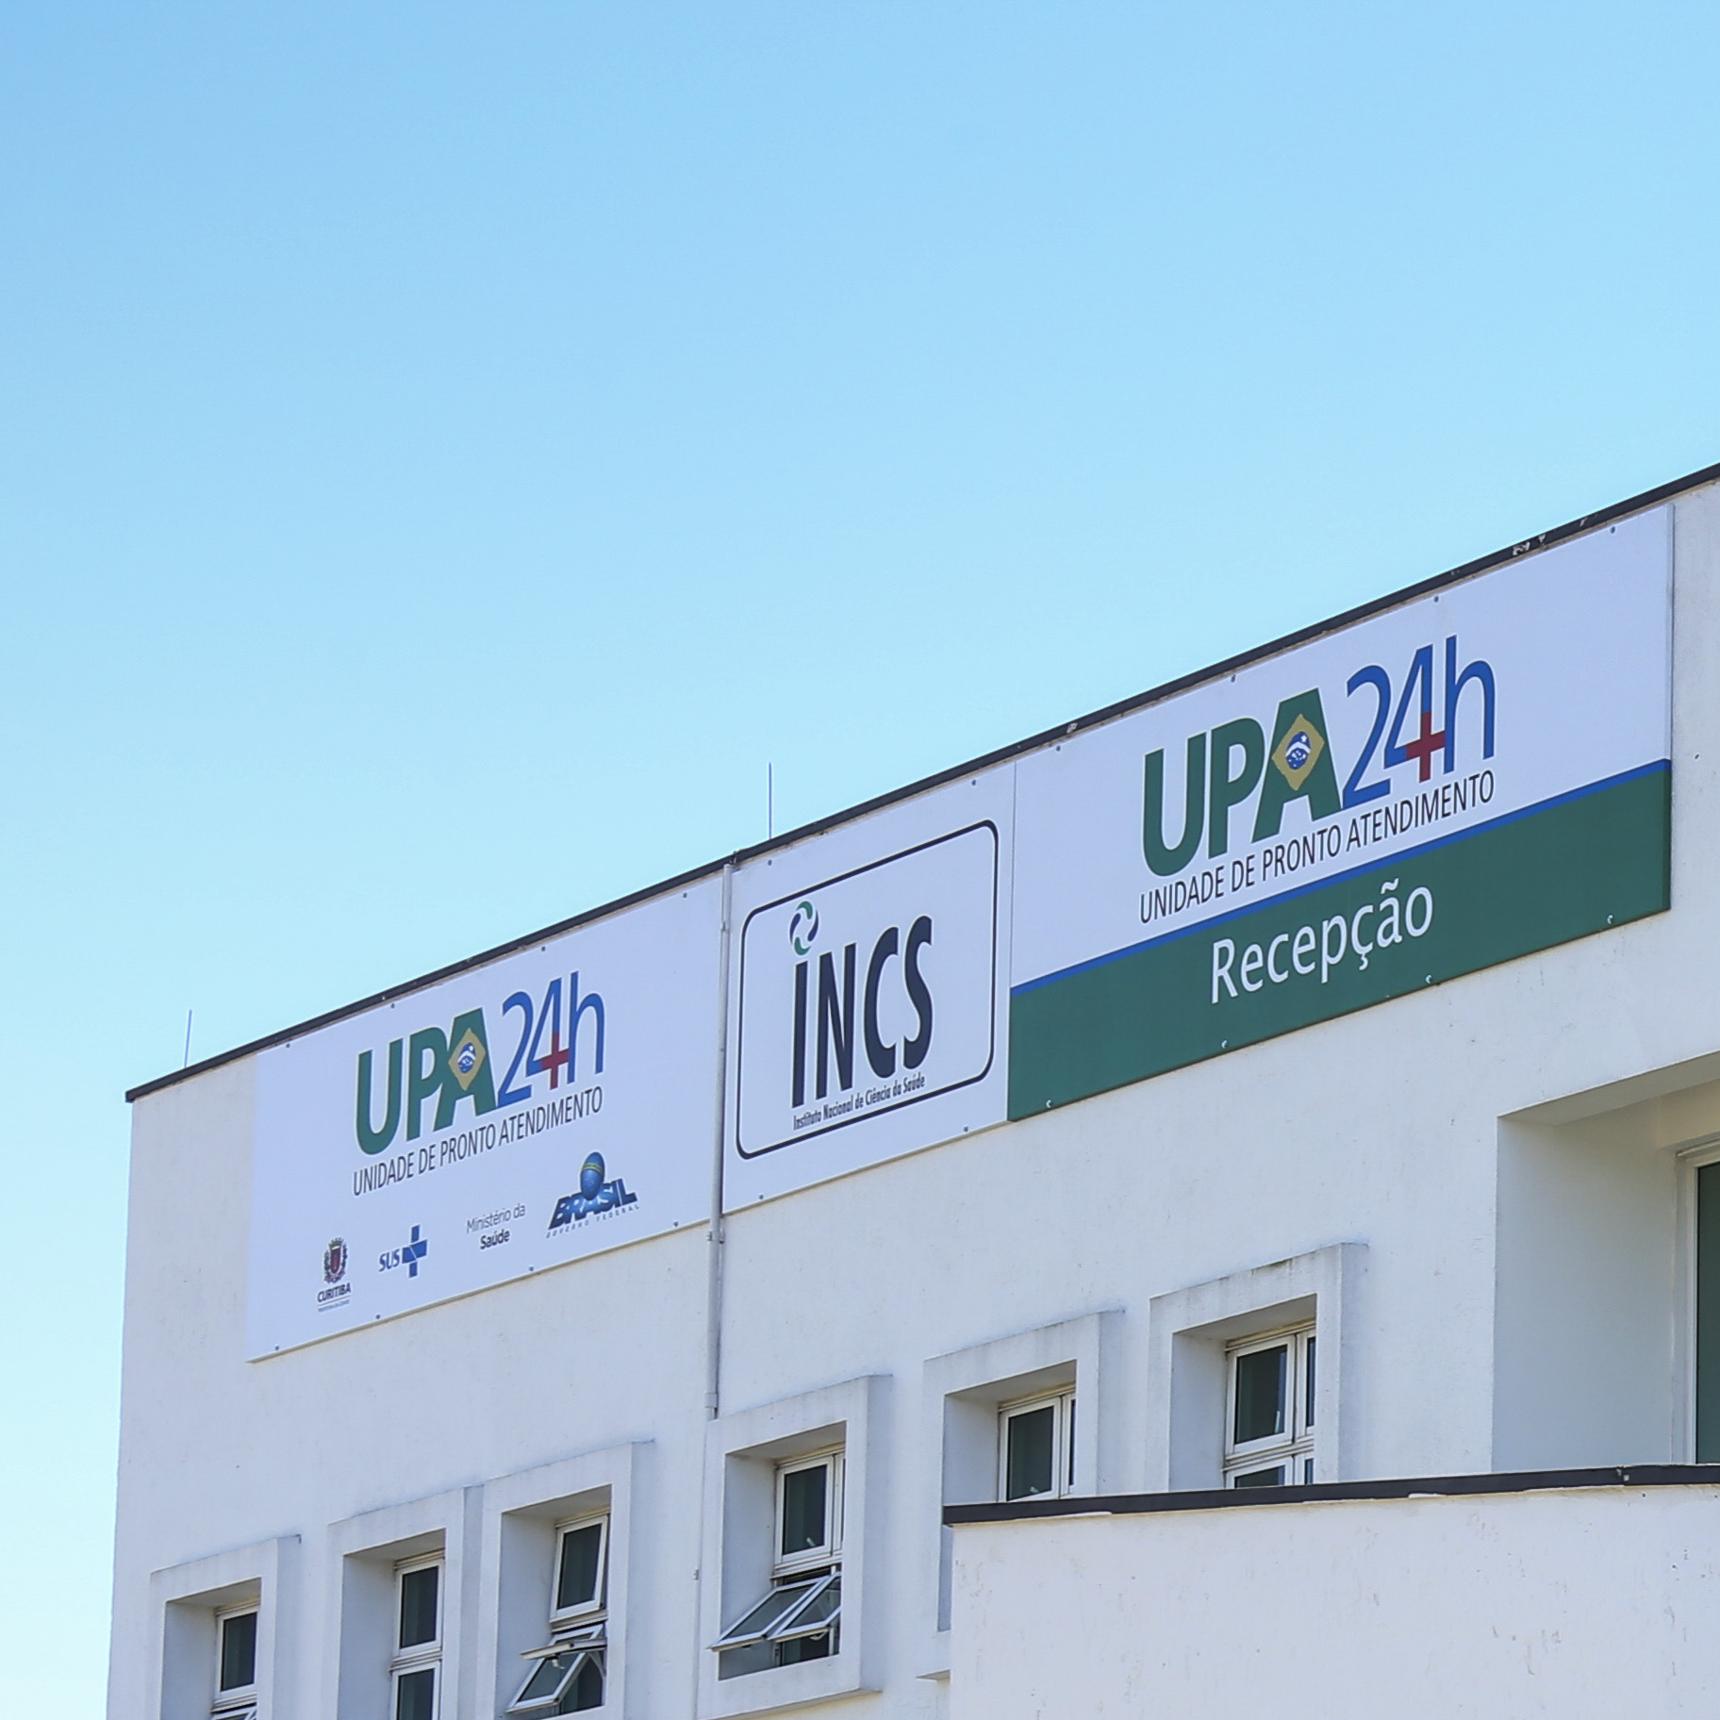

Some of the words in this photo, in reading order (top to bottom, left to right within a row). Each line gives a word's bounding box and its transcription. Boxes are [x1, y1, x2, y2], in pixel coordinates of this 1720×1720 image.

[1140, 865, 1225, 924] UNIDADE
[1231, 855, 1255, 893] DE
[1262, 825, 1341, 881] PRONTO
[1346, 770, 1494, 852] ATENDIMENTO
[1211, 878, 1433, 1005] Recepção
[793, 1109, 821, 1130] Instituto
[823, 1095, 853, 1120] Nacional
[855, 1093, 863, 1109] de
[865, 1084, 891, 1105] Ciência
[893, 1079, 901, 1097] da
[903, 1072, 925, 1093] Saúde
[353, 1152, 414, 1196] UNIDADE
[418, 1144, 436, 1175] DE
[440, 1123, 496, 1167] PRONTO
[499, 1086, 602, 1146] ATENDIMENTO
[467, 1208, 511, 1234] Ministério
[513, 1203, 525, 1218] da
[548, 1178, 638, 1230] BRASIL
[379, 1249, 400, 1272] SUS
[480, 1229, 510, 1250] Saúde
[317, 1282, 351, 1303] CURITIBA
